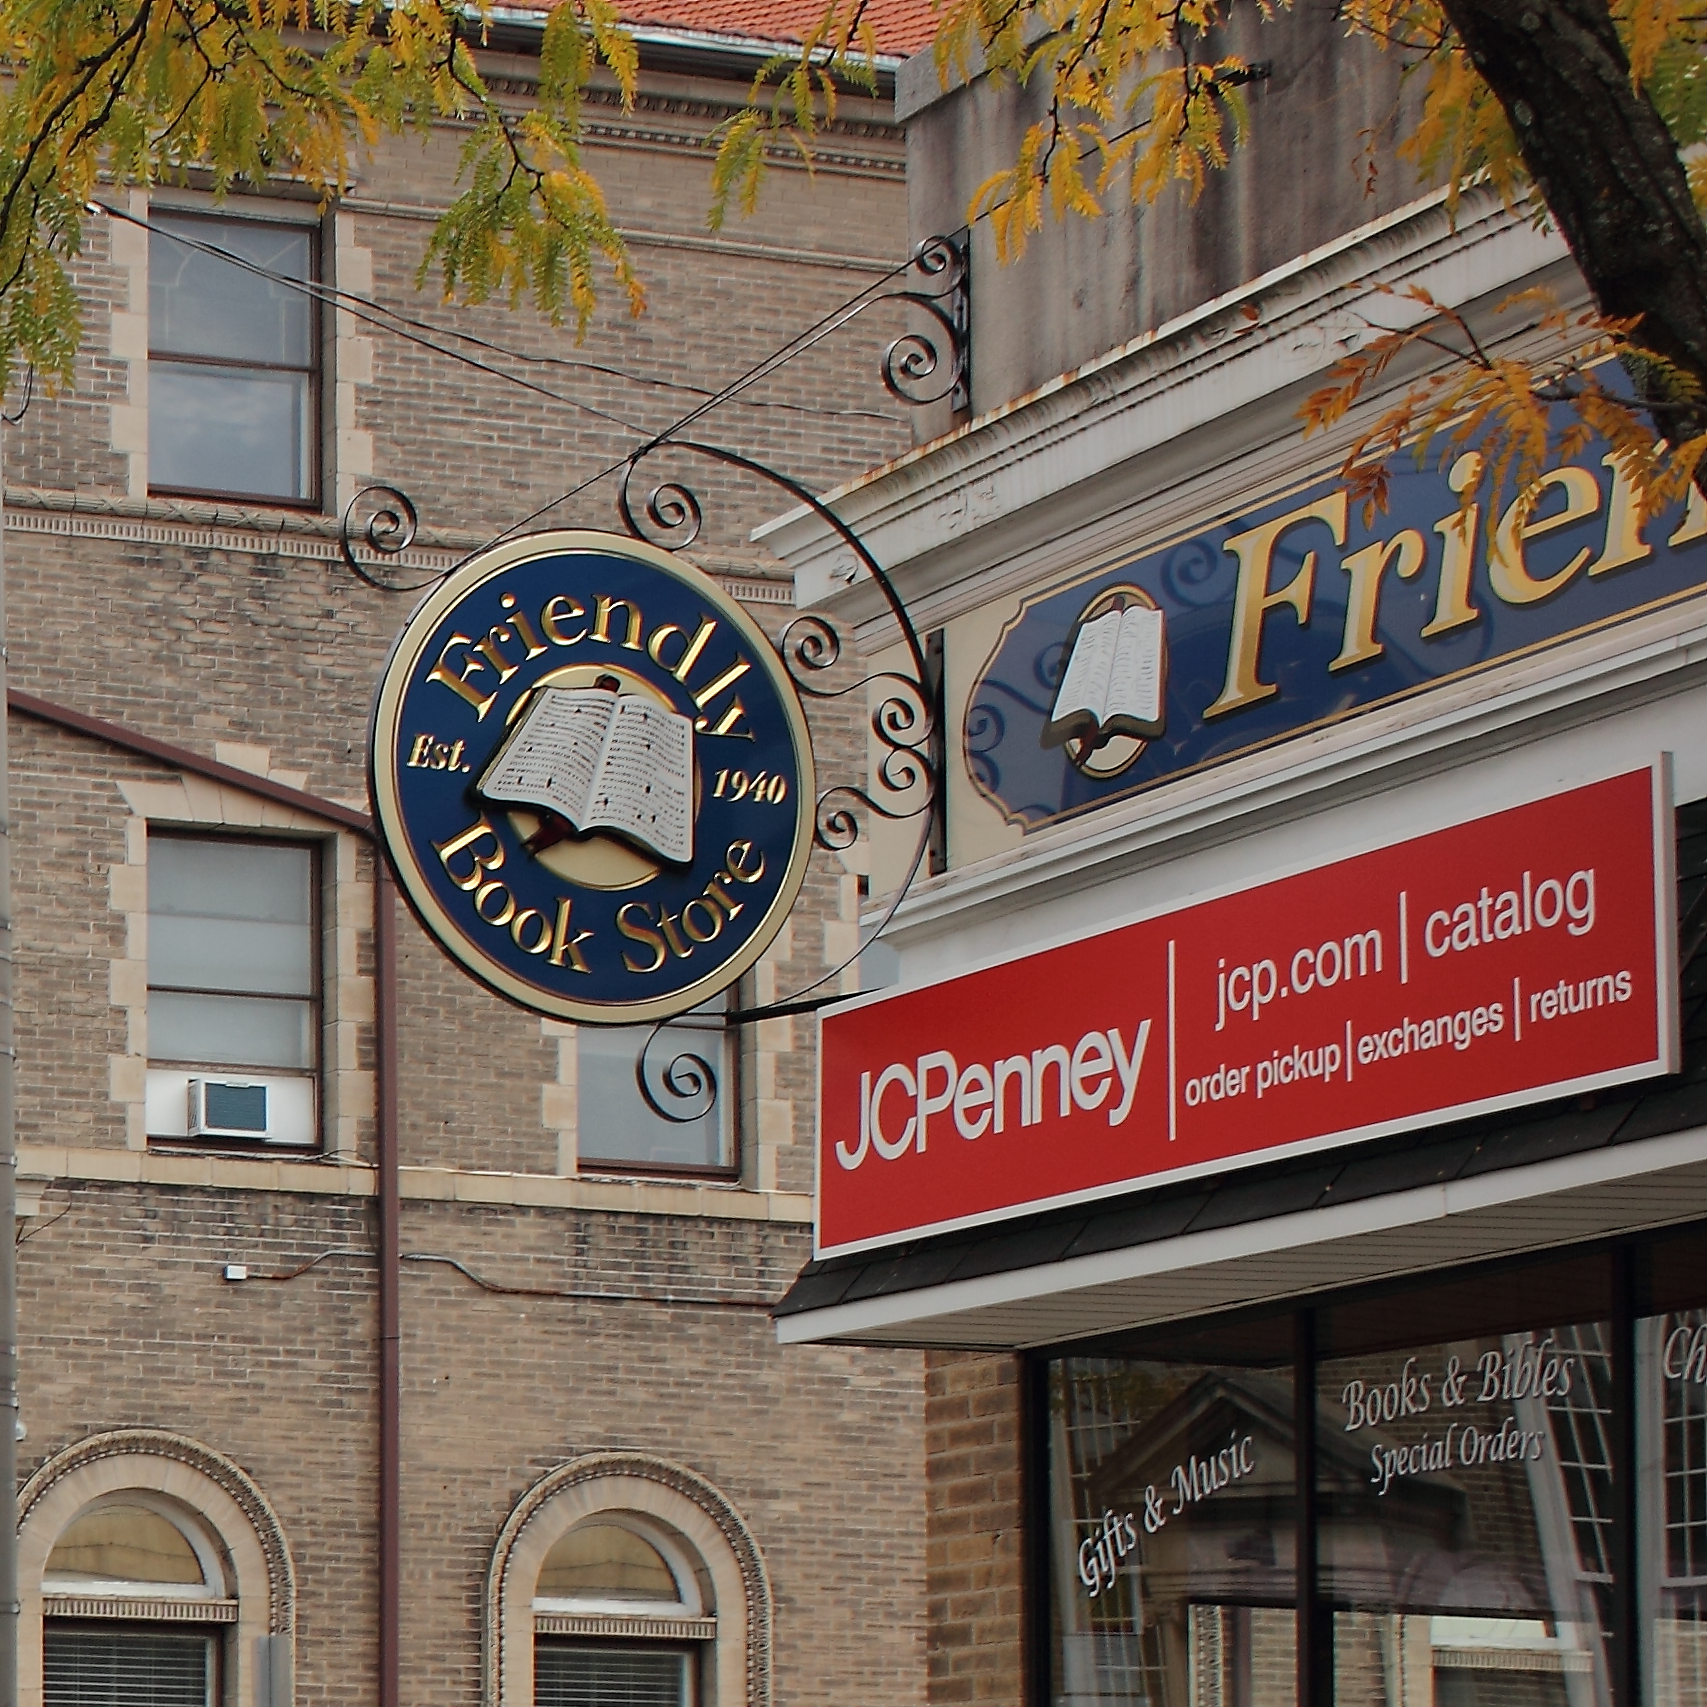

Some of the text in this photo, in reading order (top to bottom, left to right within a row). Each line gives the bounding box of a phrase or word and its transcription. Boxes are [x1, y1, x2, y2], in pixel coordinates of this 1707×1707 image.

[425, 590, 757, 743] Friendly
[406, 734, 472, 774] Est.
[711, 767, 787, 805] 1940
[429, 810, 767, 976] Book Store
[1215, 868, 1597, 1031] jcp.com catalog
[835, 1018, 1152, 1174] JCPenney
[1184, 968, 1632, 1108] order pickup exchanges returns
[1342, 1337, 1574, 1432] Books & Bibles
[1370, 1416, 1545, 1496] Special Orders
[1078, 1429, 1255, 1598] Gifts & Music
